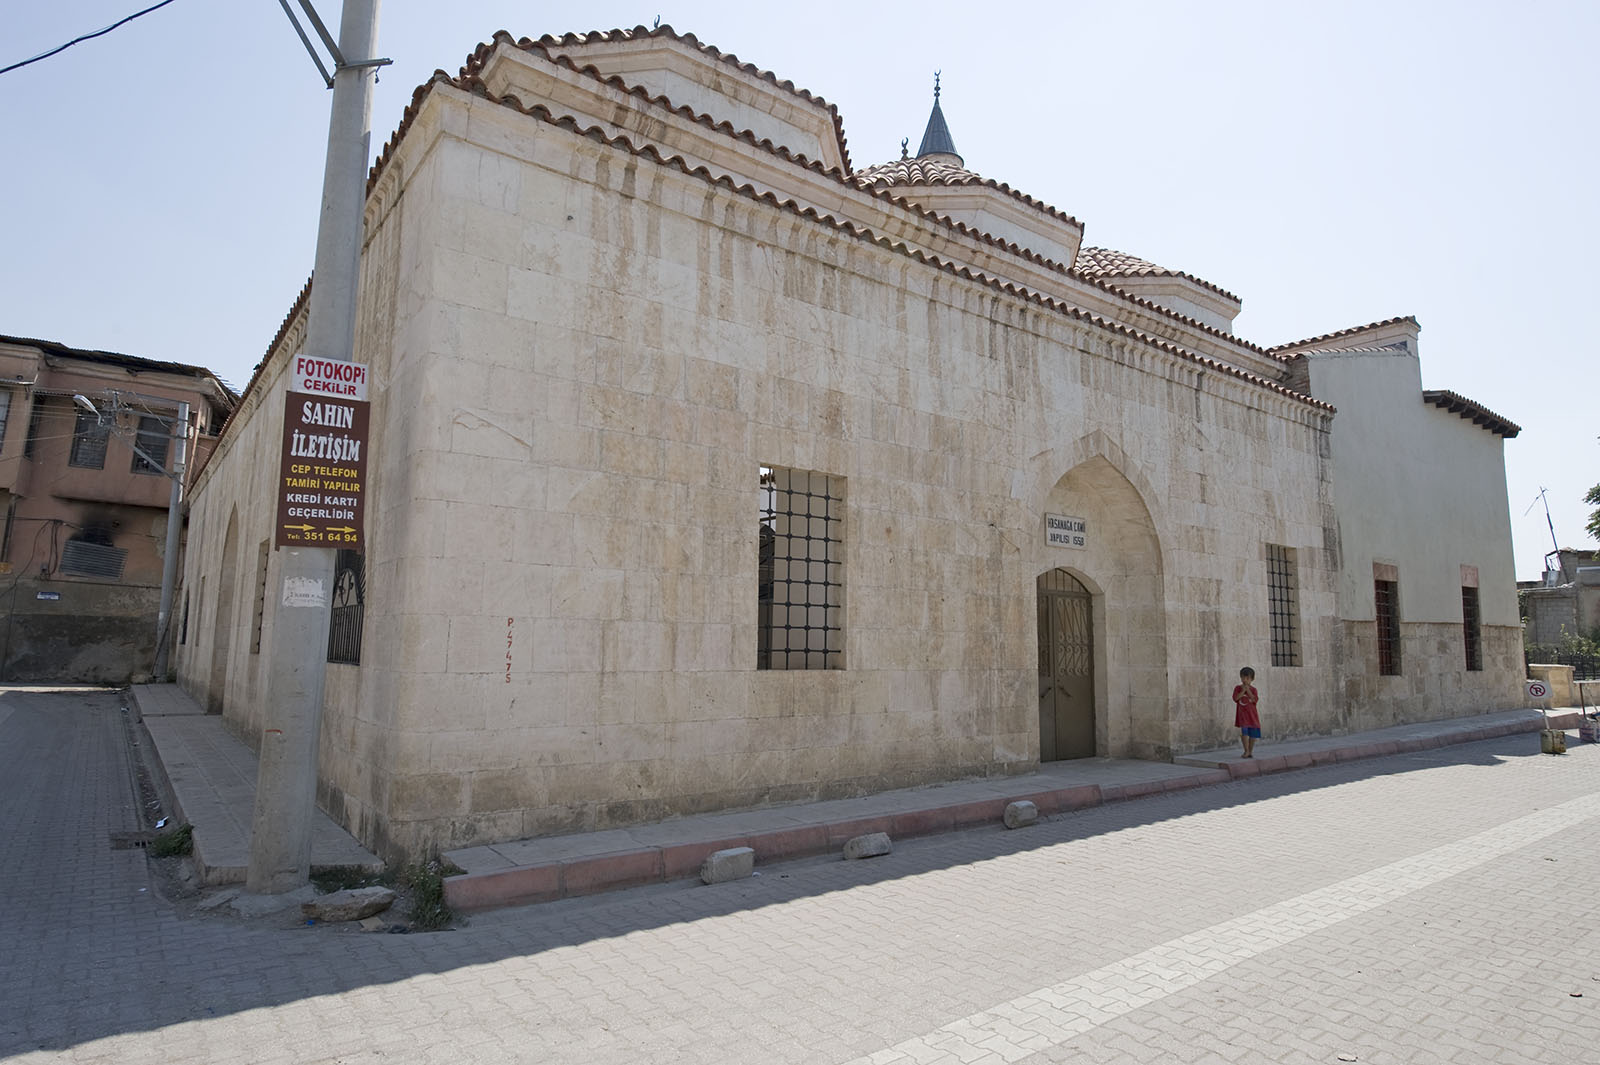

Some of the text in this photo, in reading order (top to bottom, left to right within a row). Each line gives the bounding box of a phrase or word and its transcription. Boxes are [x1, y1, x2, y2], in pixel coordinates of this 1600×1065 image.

[291, 428, 361, 464] İLETİŞİM
[291, 464, 358, 478] CEP TELEFON
[286, 477, 361, 493] TAMİRİ YAPILIR
[286, 493, 358, 507] KREDİ KARTI
[288, 507, 355, 520] GEÇERLİDİR
[304, 531, 323, 541] 351
[327, 533, 341, 542] 64
[344, 534, 358, 542] 94
